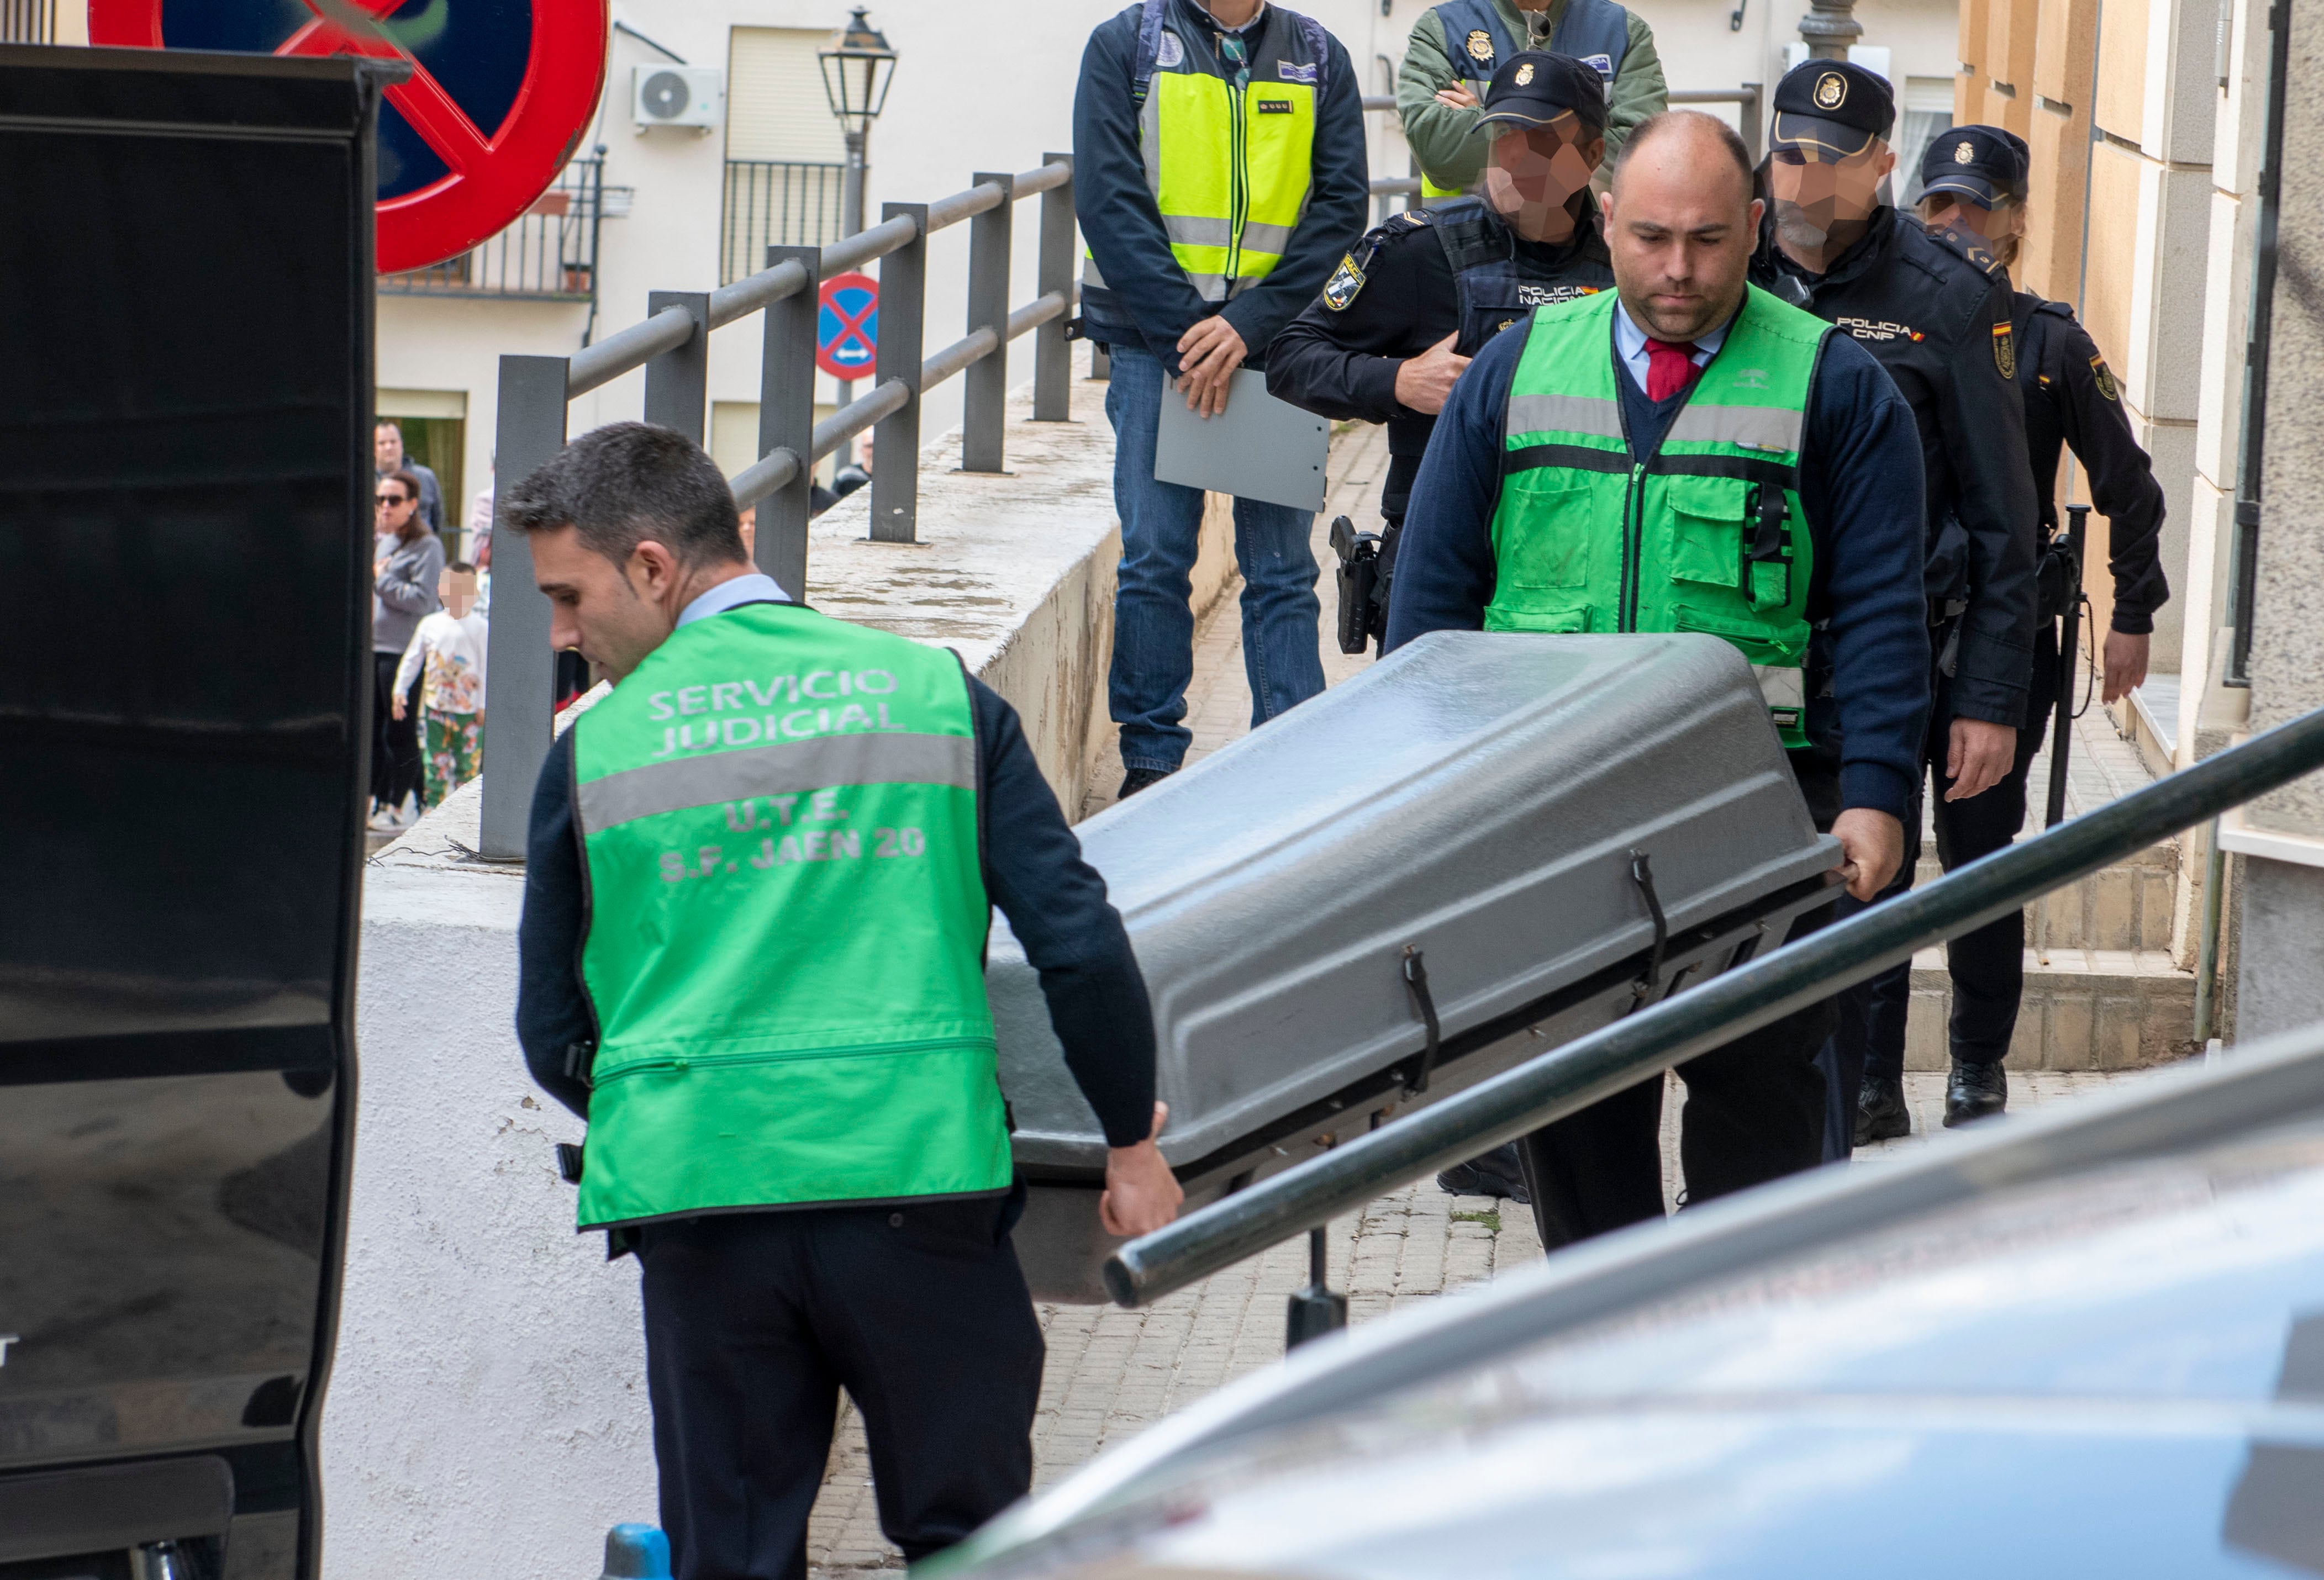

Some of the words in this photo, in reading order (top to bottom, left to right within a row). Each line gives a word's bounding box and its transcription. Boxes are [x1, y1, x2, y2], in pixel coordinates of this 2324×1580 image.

[1518, 285, 1585, 297] POLICIA
[1519, 294, 1580, 305] NACIO
[1837, 316, 1911, 336] POLICIA
[1853, 329, 1895, 340] CNP
[648, 669, 899, 721] SERVICIO
[651, 702, 907, 757] JUDICIAL
[725, 791, 849, 832] U.T.E.
[660, 846, 738, 883] S.F.
[751, 829, 861, 870] JAEN
[874, 827, 926, 858] 20
